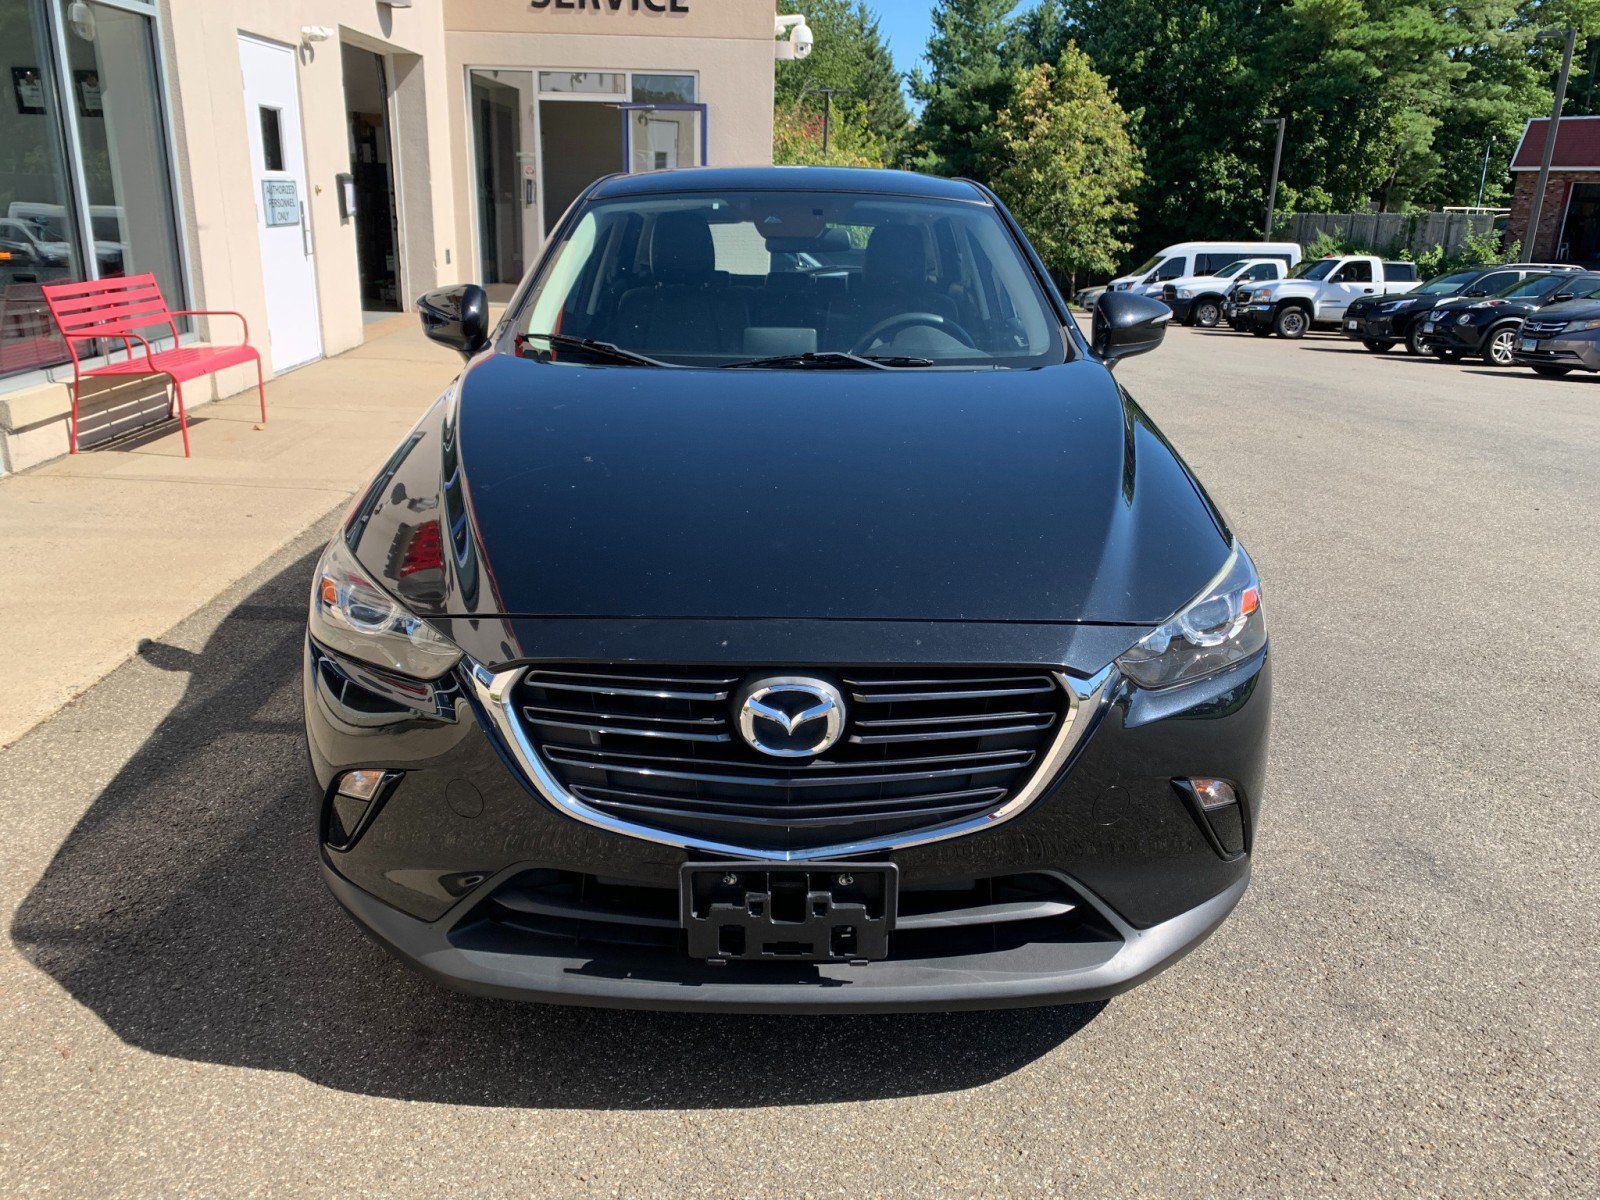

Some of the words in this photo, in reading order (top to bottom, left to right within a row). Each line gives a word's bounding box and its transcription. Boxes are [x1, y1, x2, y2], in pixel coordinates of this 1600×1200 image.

[266, 185, 295, 195] AUTHORIZED
[268, 198, 296, 208] PERSONNEL
[277, 211, 289, 221] ONLY
